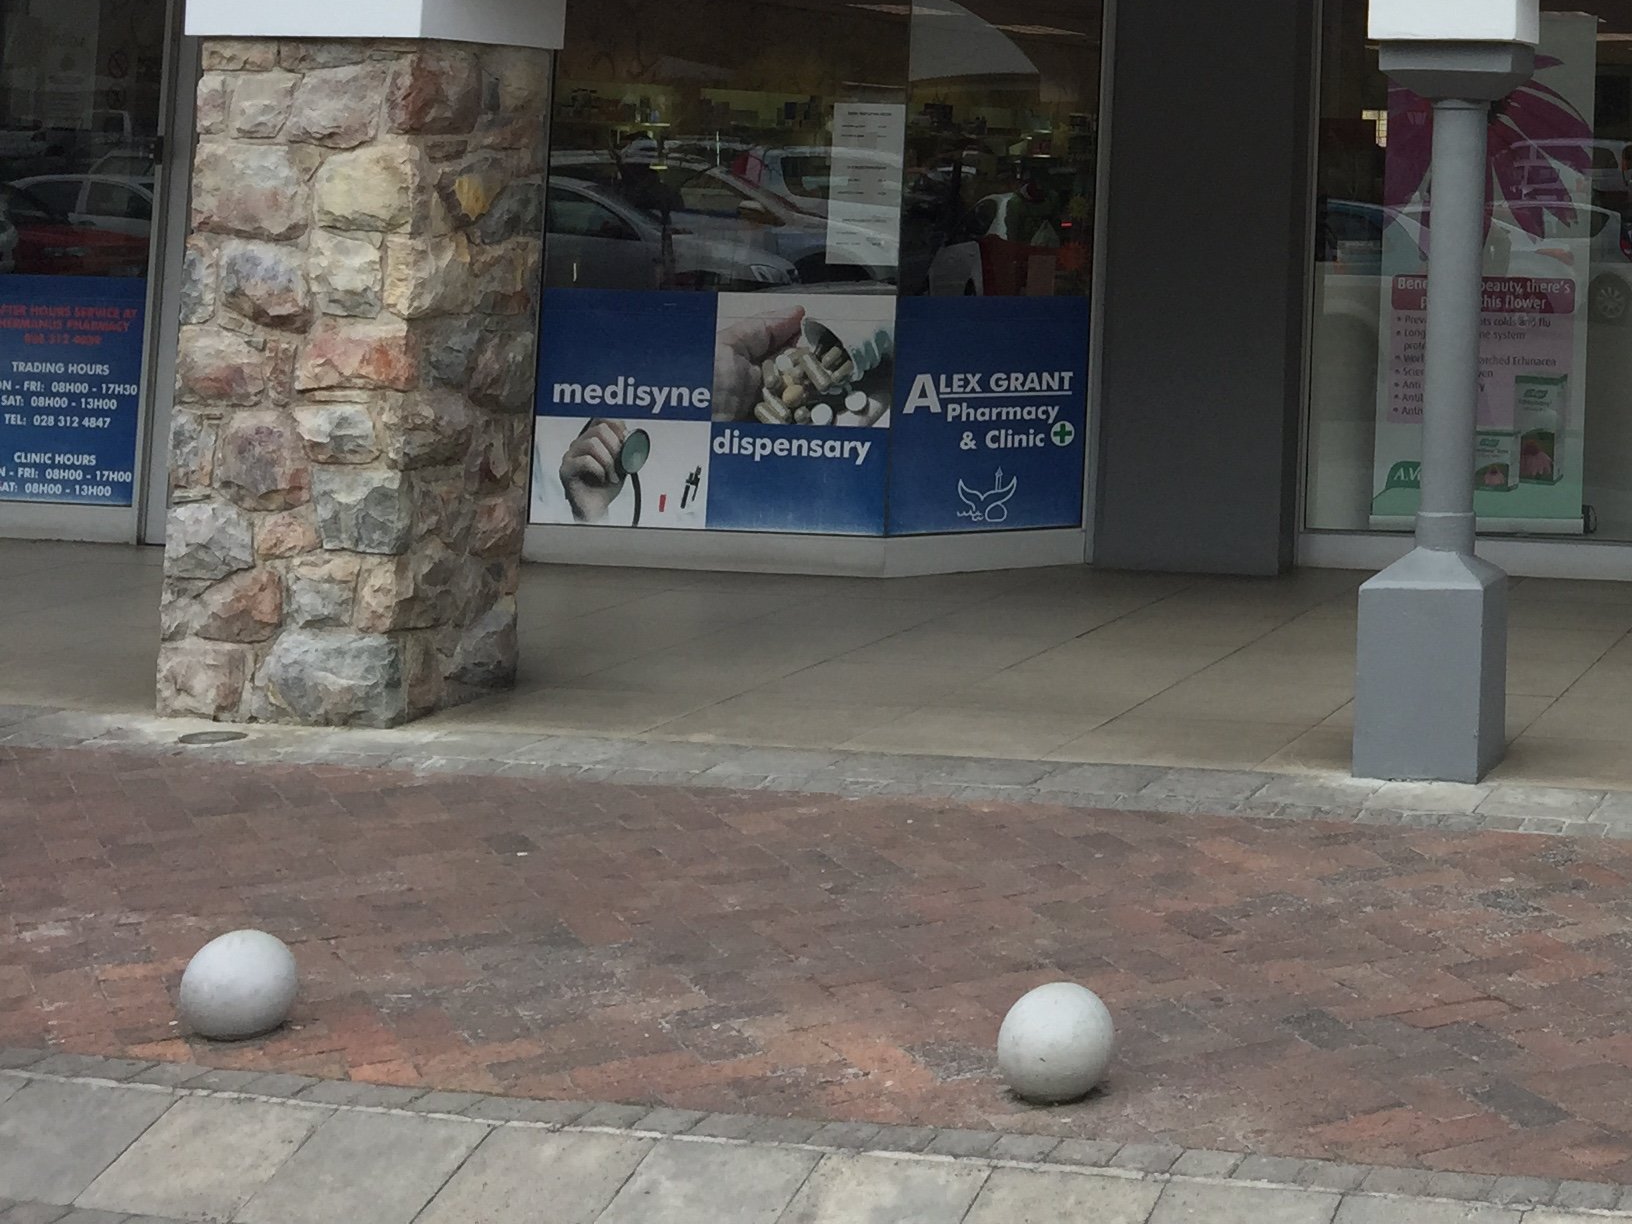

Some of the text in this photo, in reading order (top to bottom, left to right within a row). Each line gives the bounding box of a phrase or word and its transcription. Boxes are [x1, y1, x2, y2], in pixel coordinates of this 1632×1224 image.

[1526, 280, 1570, 294] there's
[1505, 294, 1546, 309] flower
[1493, 331, 1526, 342] system
[12, 362, 110, 376] TRADING HOURS
[24, 380, 45, 393] FRI:
[51, 382, 89, 394] 08H00
[101, 384, 138, 396] 17H30
[553, 377, 710, 413] medisyne
[903, 372, 1074, 414] ALEX GRANT
[1, 395, 24, 407] SAT:
[30, 396, 68, 408] 08H00
[80, 398, 118, 410] 13H00
[947, 402, 1059, 425] Pharmacy
[4, 414, 112, 429] TEL: 028 312 4847
[713, 429, 871, 464] dispensary
[960, 429, 1045, 450] & Clinic
[14, 452, 96, 466] CLINIC HOURS
[18, 468, 39, 479] FRI:
[45, 468, 84, 481] 08H00
[96, 470, 132, 483] 17H00
[25, 482, 62, 496] 08H00
[75, 484, 112, 498] 13H00
